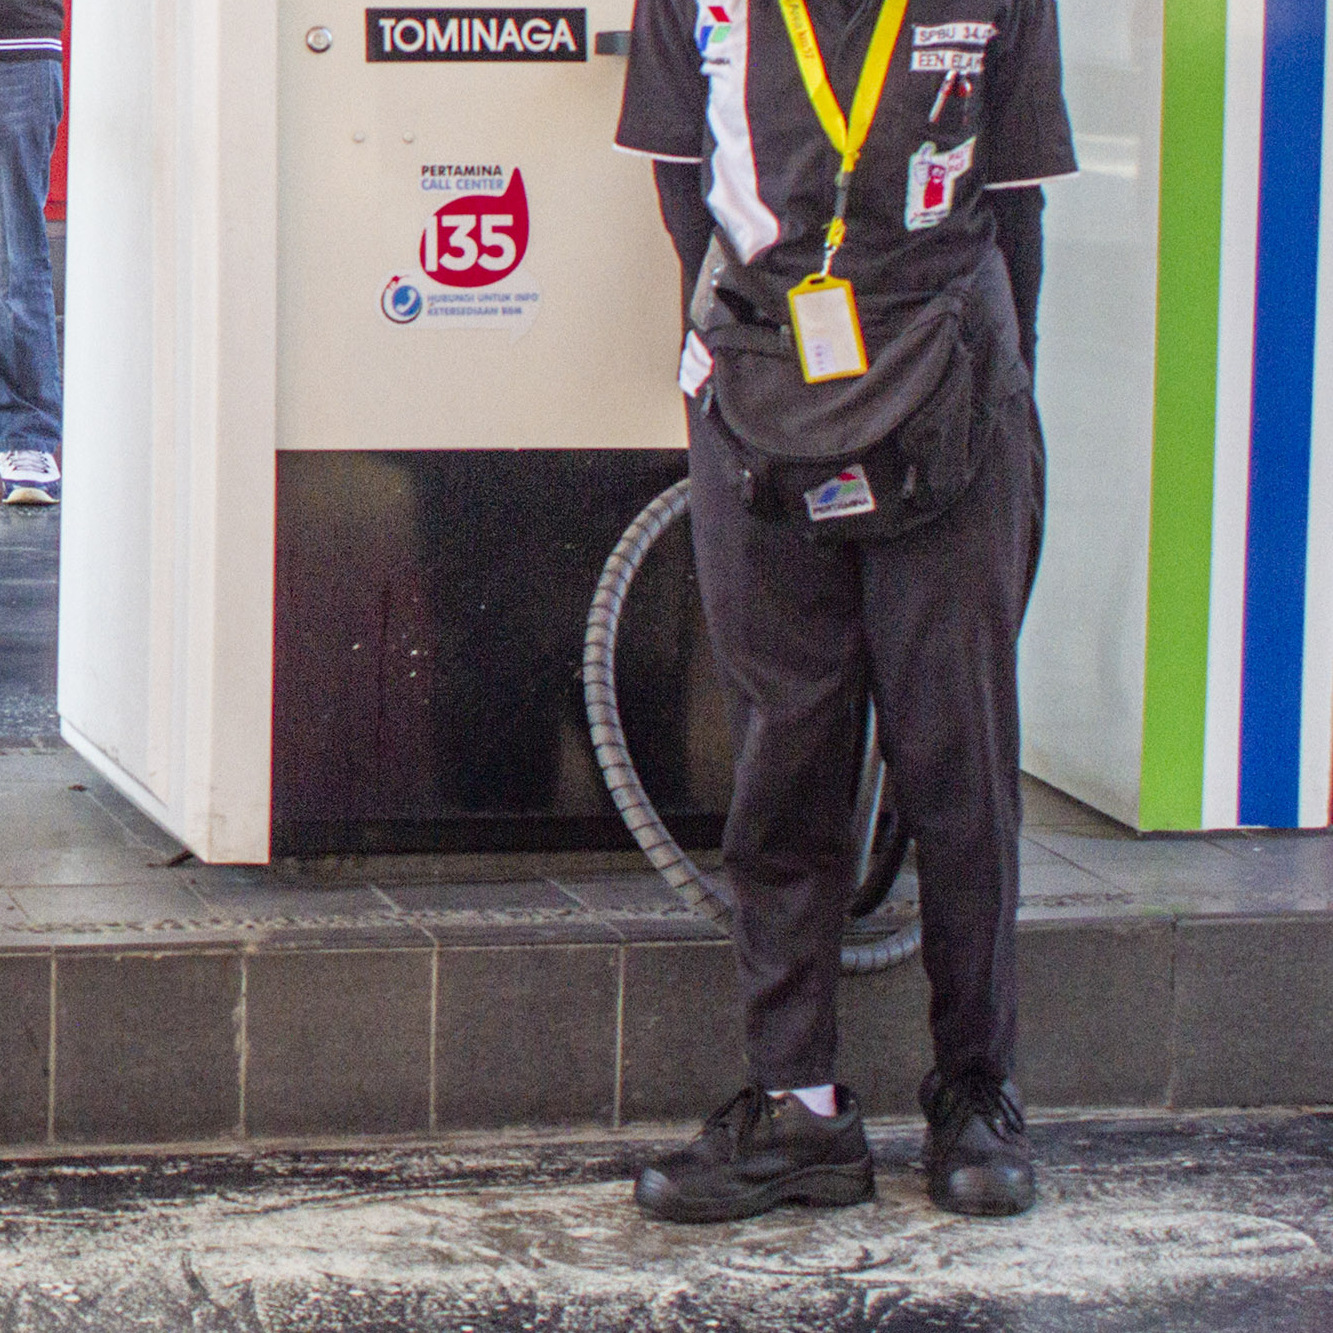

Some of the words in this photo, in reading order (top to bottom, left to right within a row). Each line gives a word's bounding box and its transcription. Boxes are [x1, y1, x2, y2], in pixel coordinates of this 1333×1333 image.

[378, 18, 578, 53] TOMINAGA
[919, 26, 955, 42] SPBU
[421, 165, 503, 177] PERTAMINA
[421, 178, 451, 191] CALL
[456, 178, 504, 191] CENTER
[424, 214, 517, 272] 135
